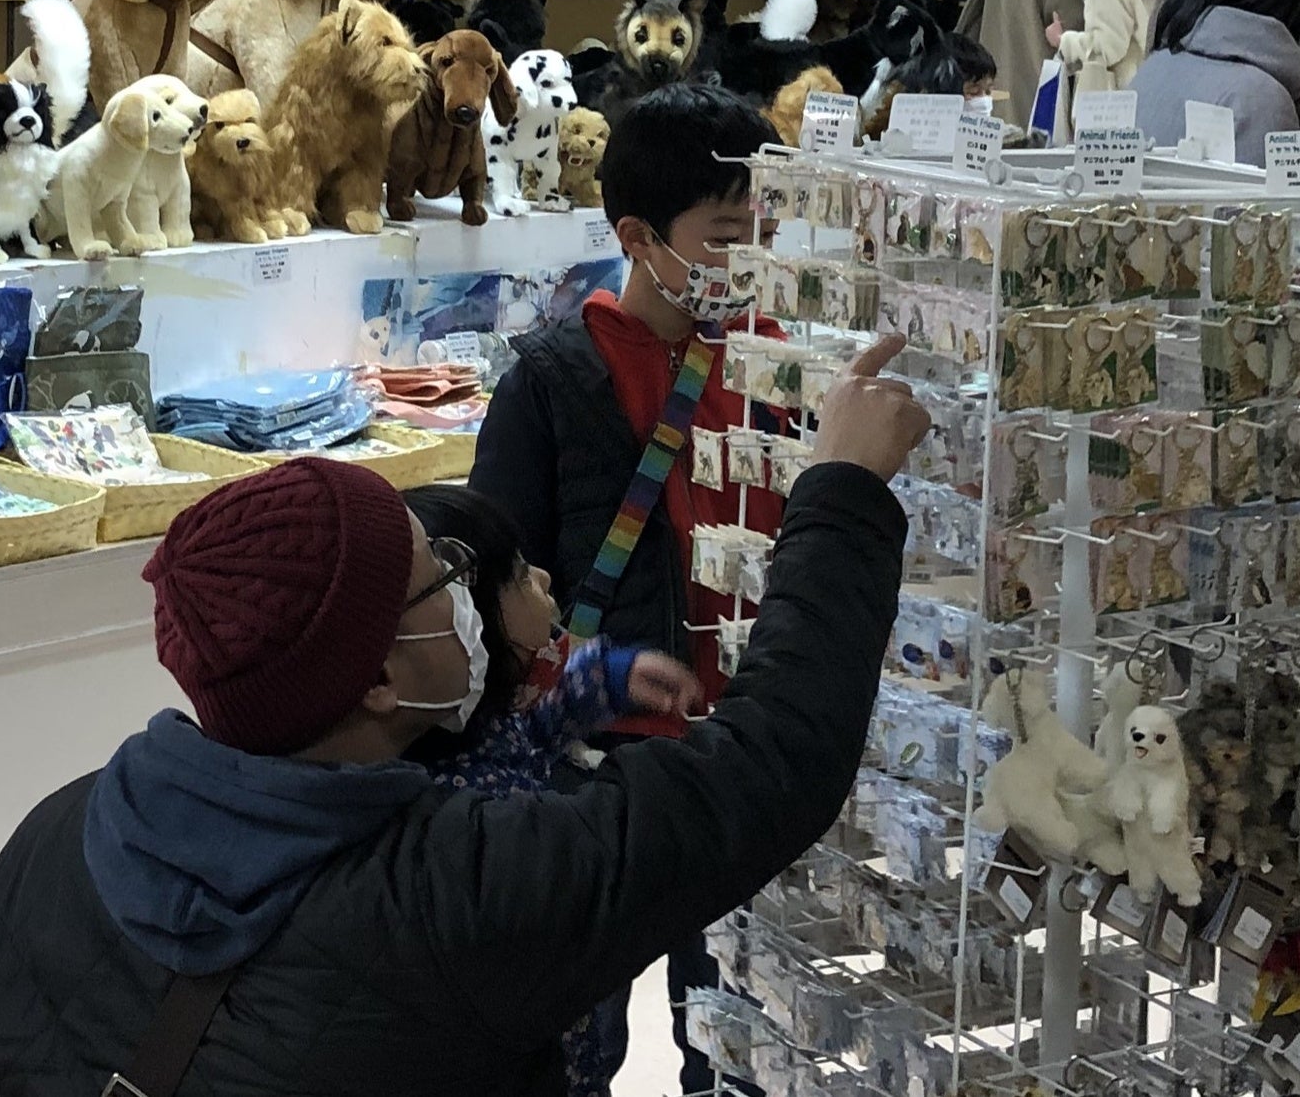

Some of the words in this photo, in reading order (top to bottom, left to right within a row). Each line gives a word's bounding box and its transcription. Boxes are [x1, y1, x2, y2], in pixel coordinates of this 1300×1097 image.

[1079, 130, 1107, 141] Animal
[1111, 129, 1140, 141] Friends
[1268, 133, 1297, 144] Animal
